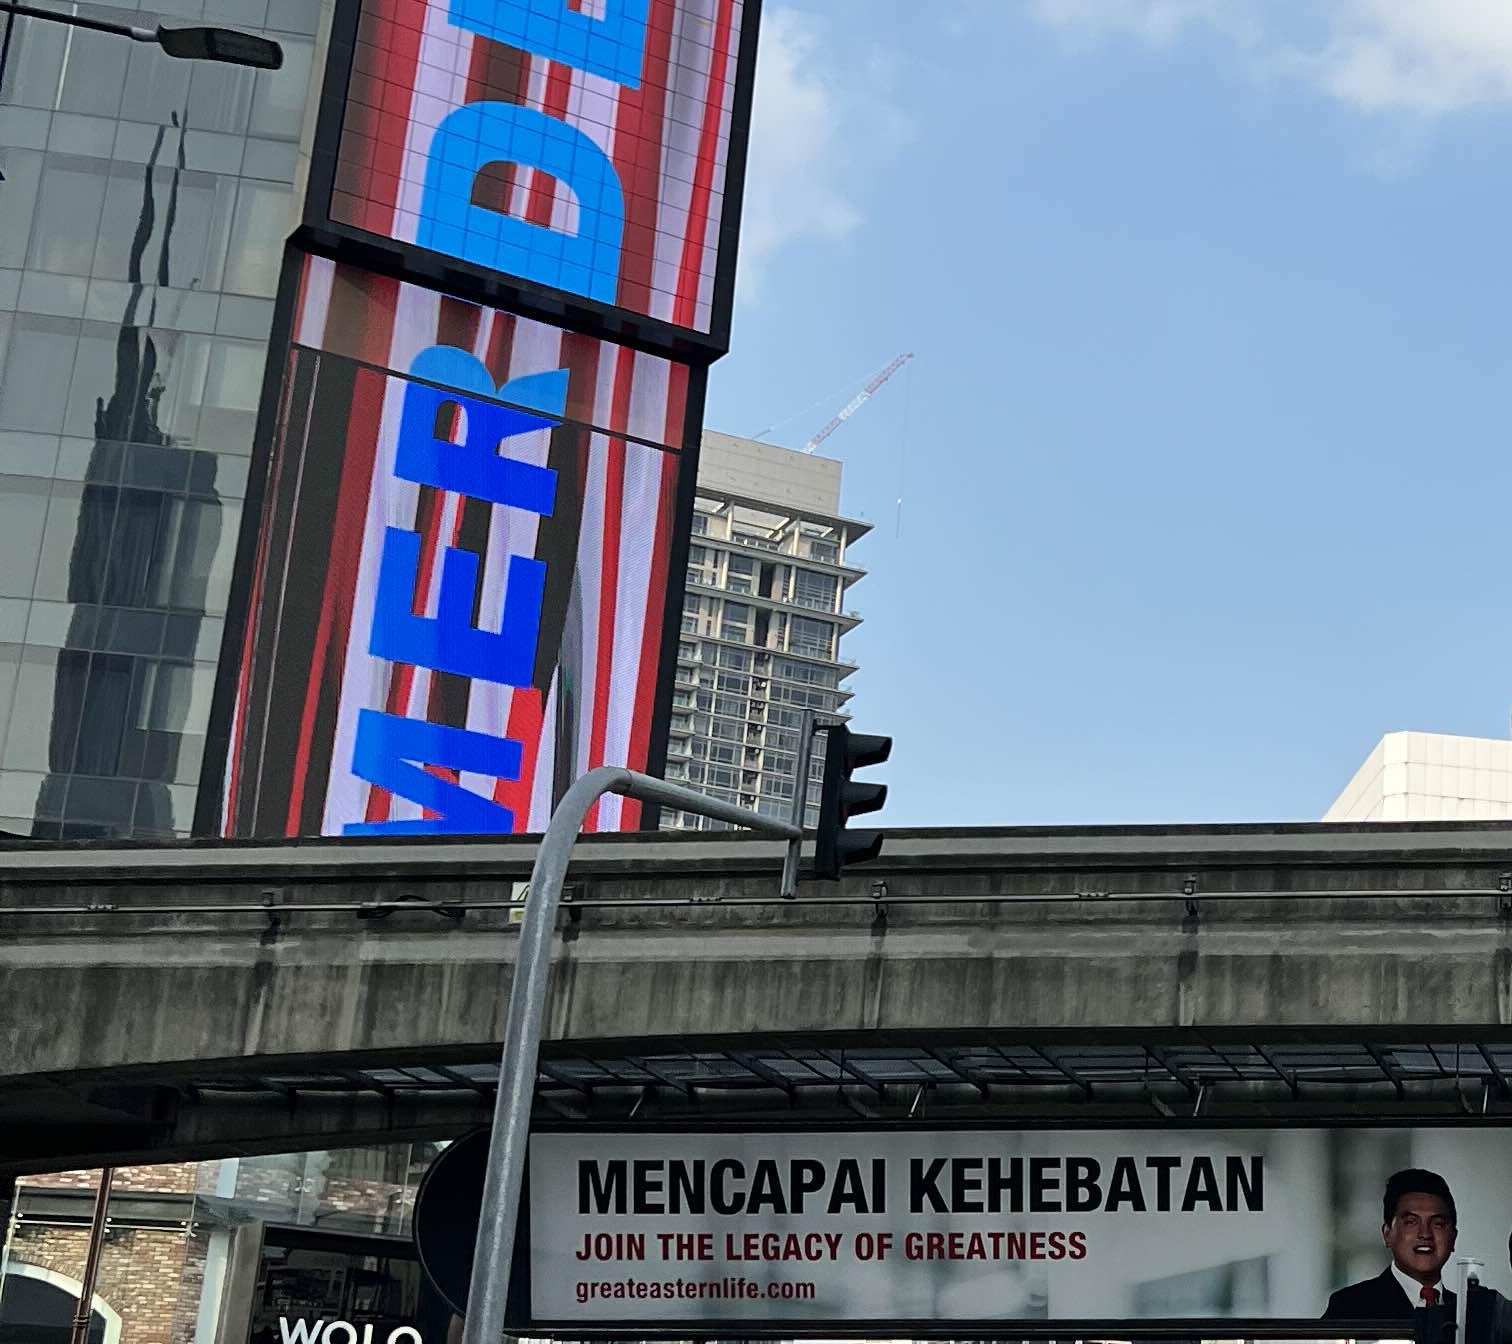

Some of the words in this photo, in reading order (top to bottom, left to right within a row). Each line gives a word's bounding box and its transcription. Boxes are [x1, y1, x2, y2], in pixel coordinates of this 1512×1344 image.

[578, 1158, 886, 1215] MENCAPAI
[909, 1155, 1265, 1214] KEHEBATAN
[575, 1232, 646, 1261] JOIN
[656, 1232, 714, 1261] THE
[726, 1232, 843, 1261] LEGACY
[855, 1232, 893, 1261] OF
[905, 1231, 1087, 1261] GREATNESS
[576, 1276, 816, 1303] greateasternlife.com
